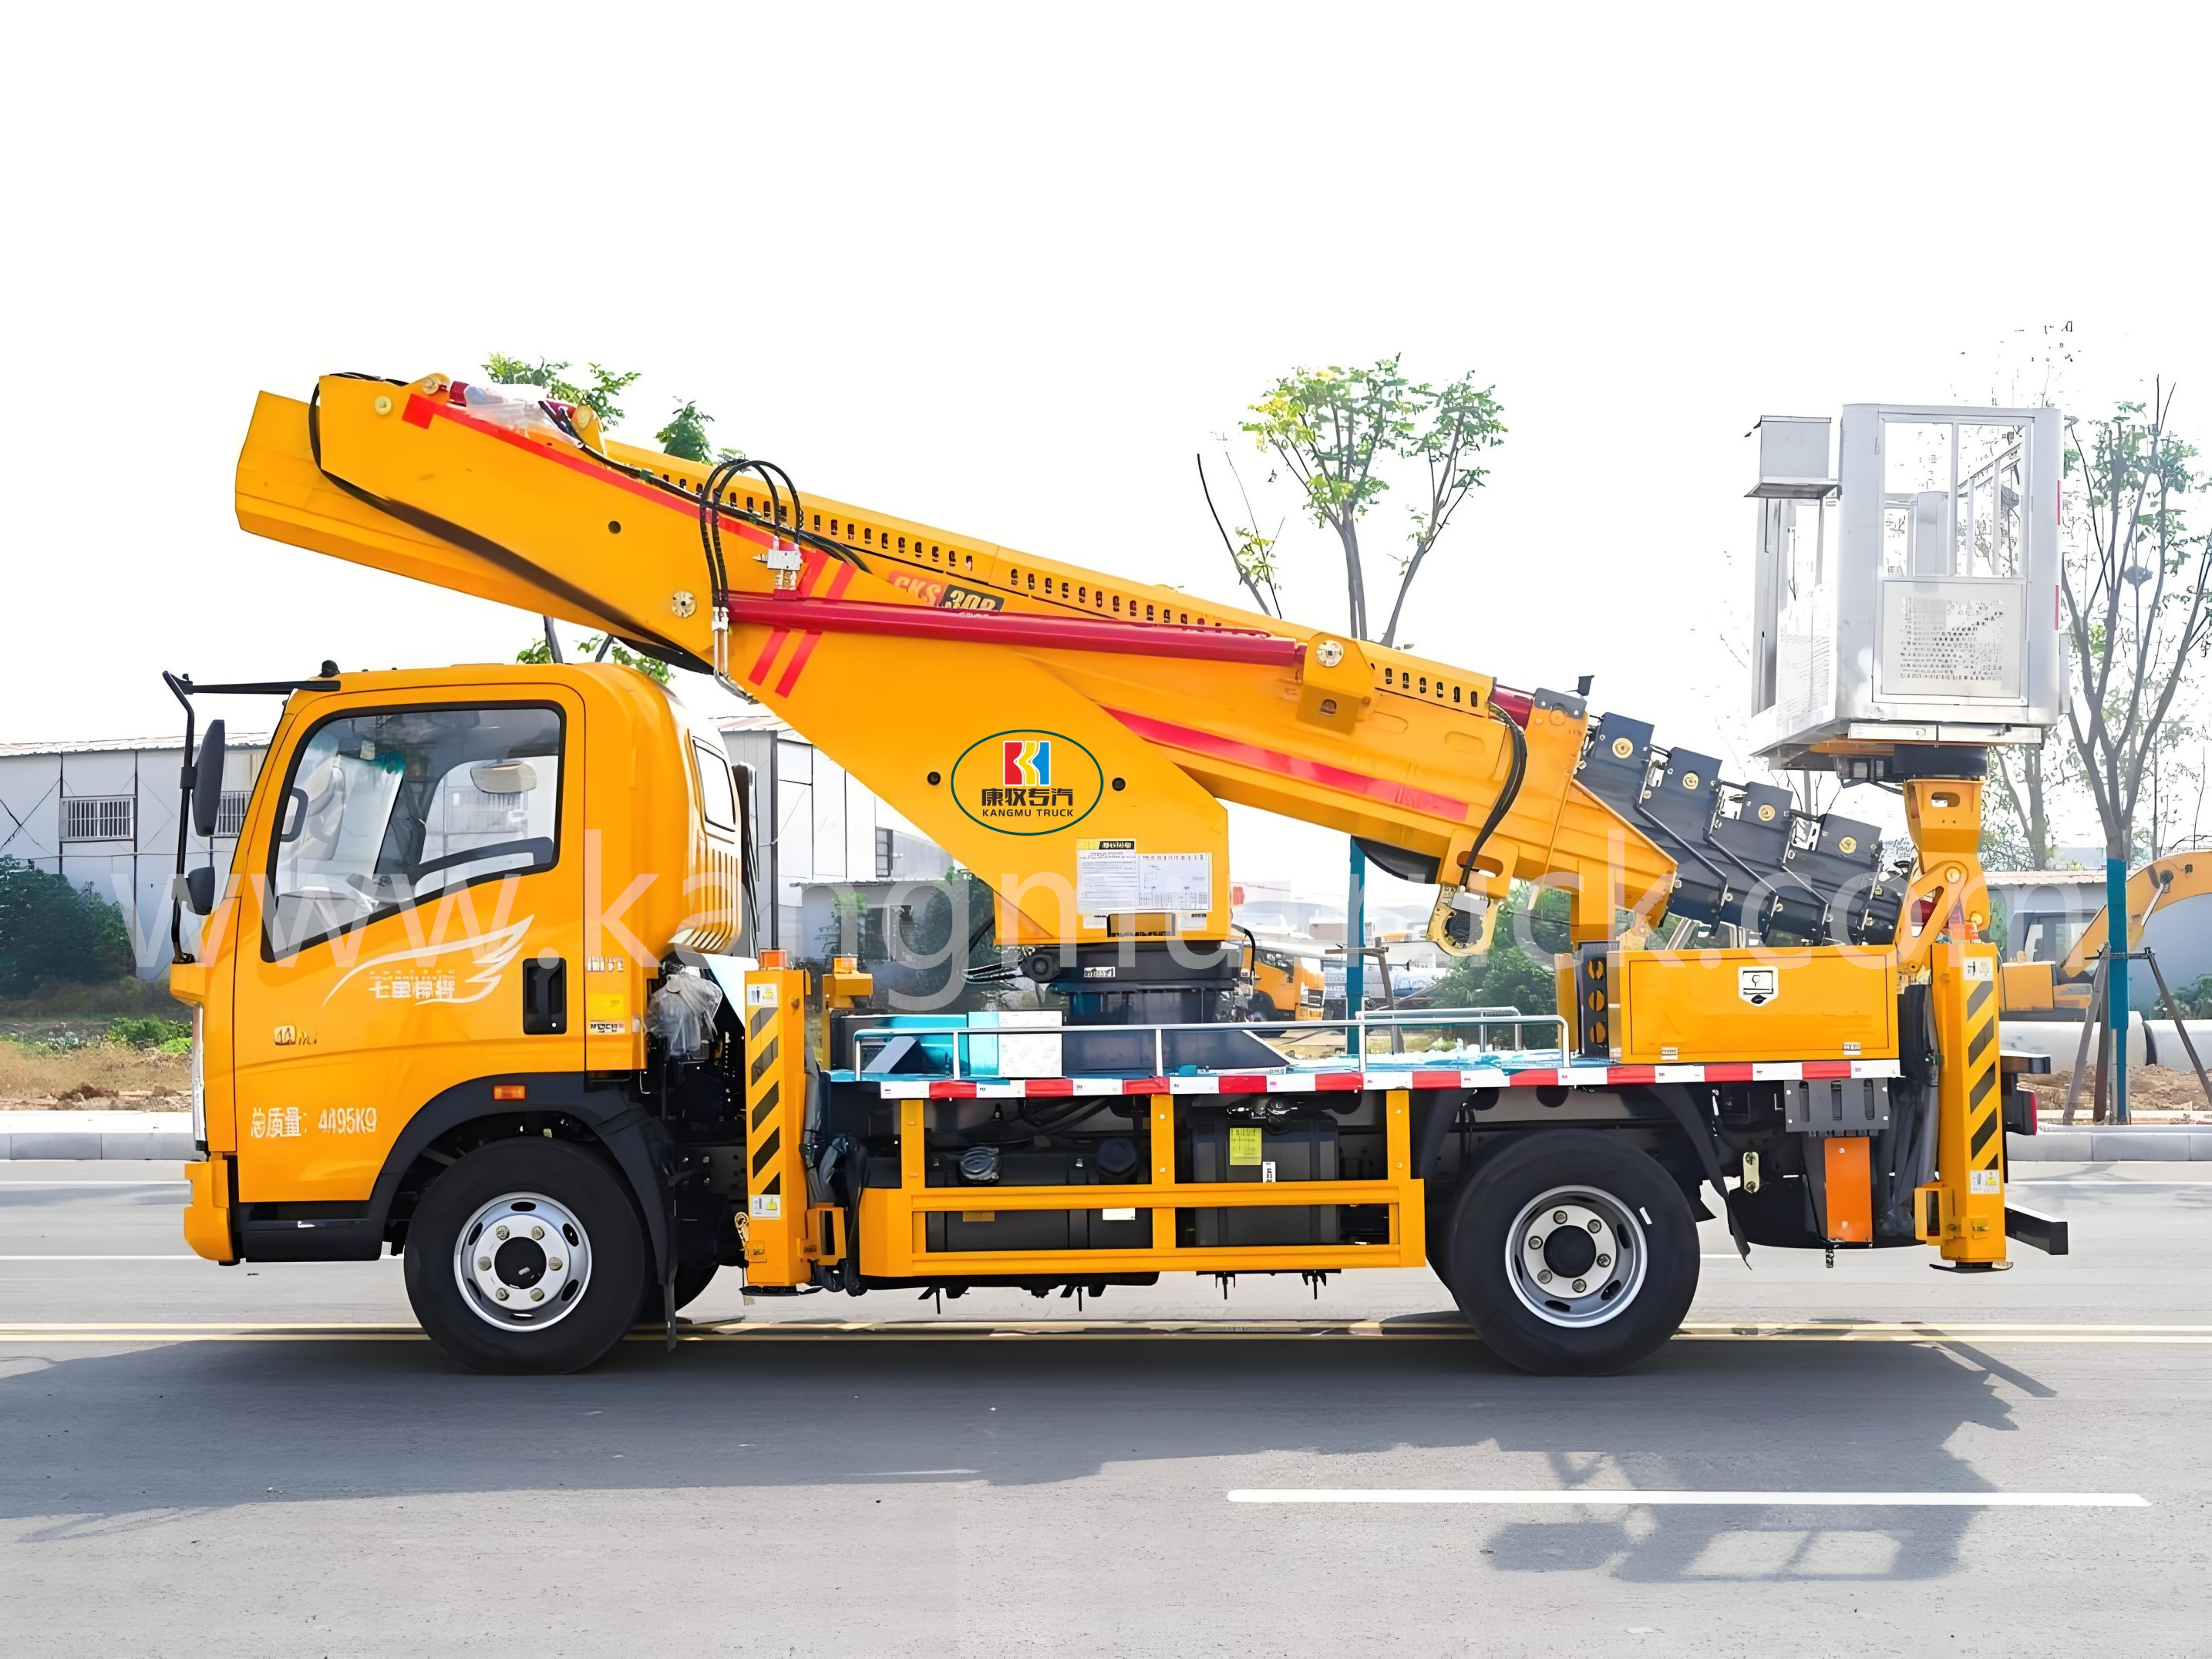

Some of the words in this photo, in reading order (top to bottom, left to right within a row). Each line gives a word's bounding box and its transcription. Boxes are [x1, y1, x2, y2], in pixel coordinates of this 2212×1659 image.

[981, 788, 1073, 806] 康牧专汽
[982, 809, 1032, 817] KANGMU
[1036, 809, 1074, 817] TRUCK
